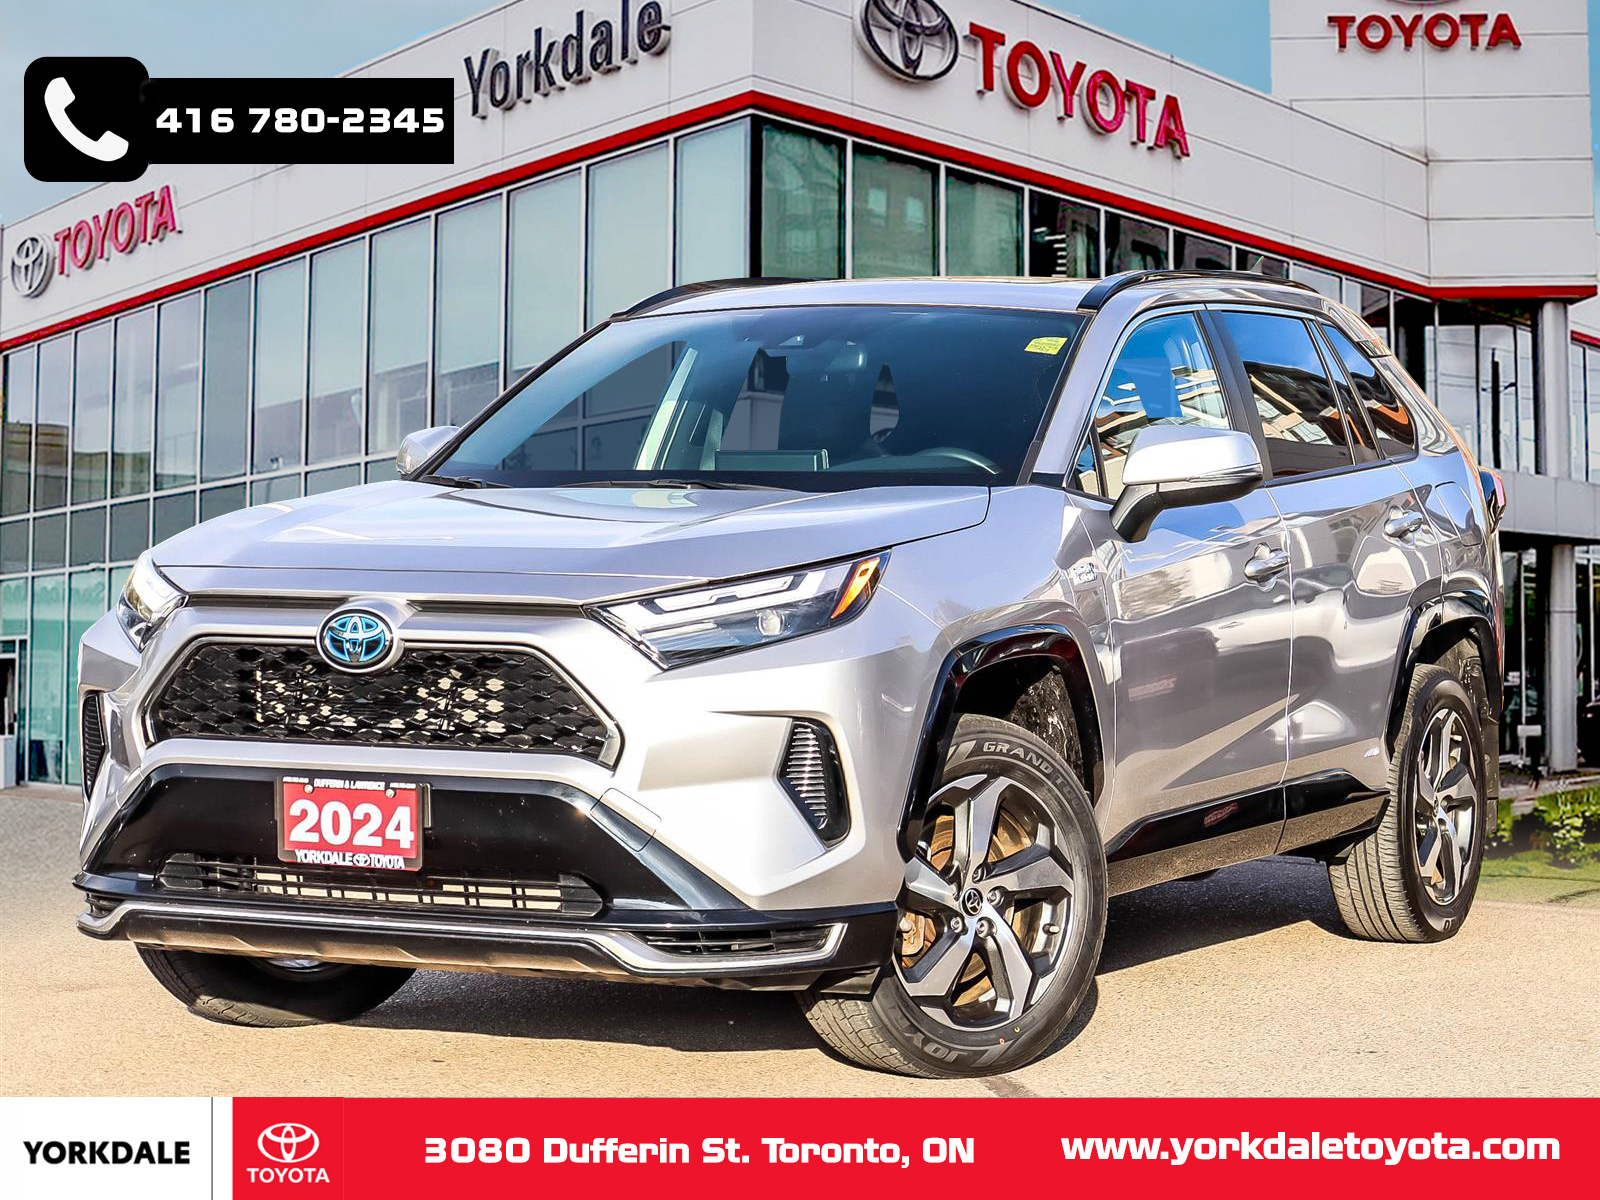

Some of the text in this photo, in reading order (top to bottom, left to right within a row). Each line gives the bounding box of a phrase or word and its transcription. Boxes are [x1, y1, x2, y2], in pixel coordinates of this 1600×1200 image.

[1328, 12, 1522, 51] TOYOTA
[464, 0, 671, 118] Yorkdale
[968, 21, 1191, 158] TOYOTA
[53, 184, 182, 276] TOYOTA
[983, 740, 1054, 774] GRAND
[288, 799, 415, 849] 2024
[294, 849, 406, 869] YORKDALE TOYOTA
